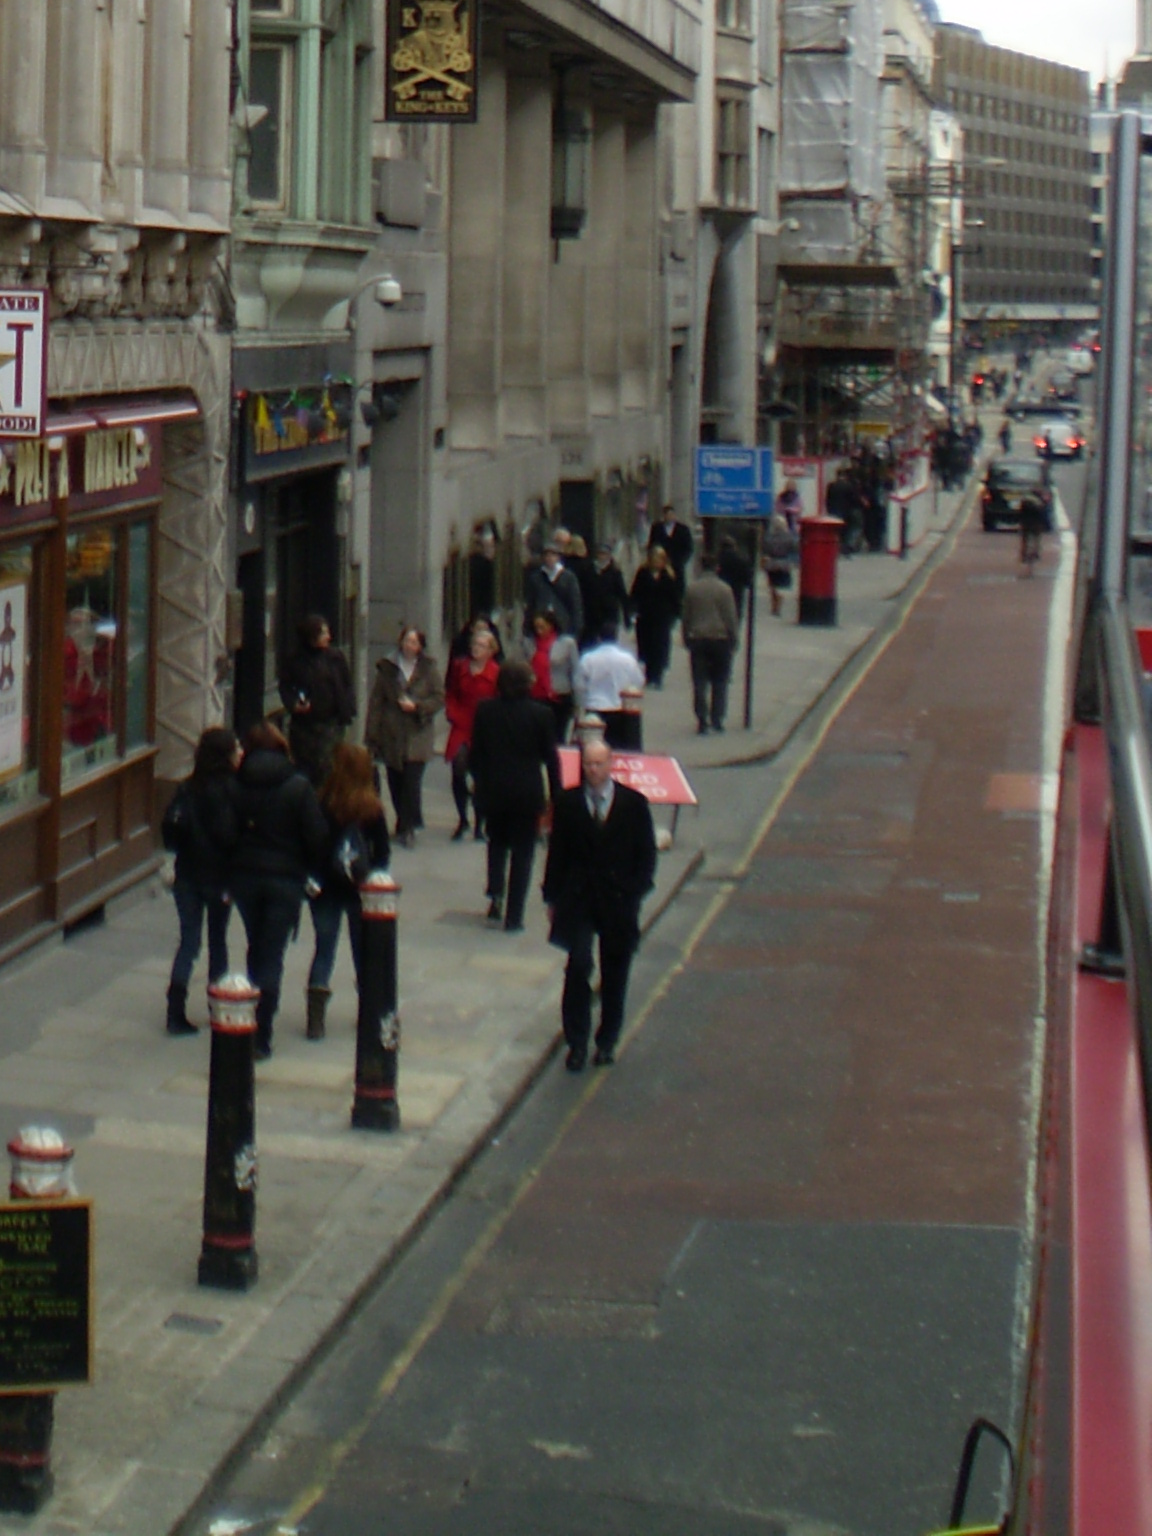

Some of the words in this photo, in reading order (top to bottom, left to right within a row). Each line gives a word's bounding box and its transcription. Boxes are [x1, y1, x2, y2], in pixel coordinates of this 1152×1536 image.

[434, 101, 469, 114] KEYS
[15, 438, 50, 506] PRET
[85, 427, 138, 495] MANGER
